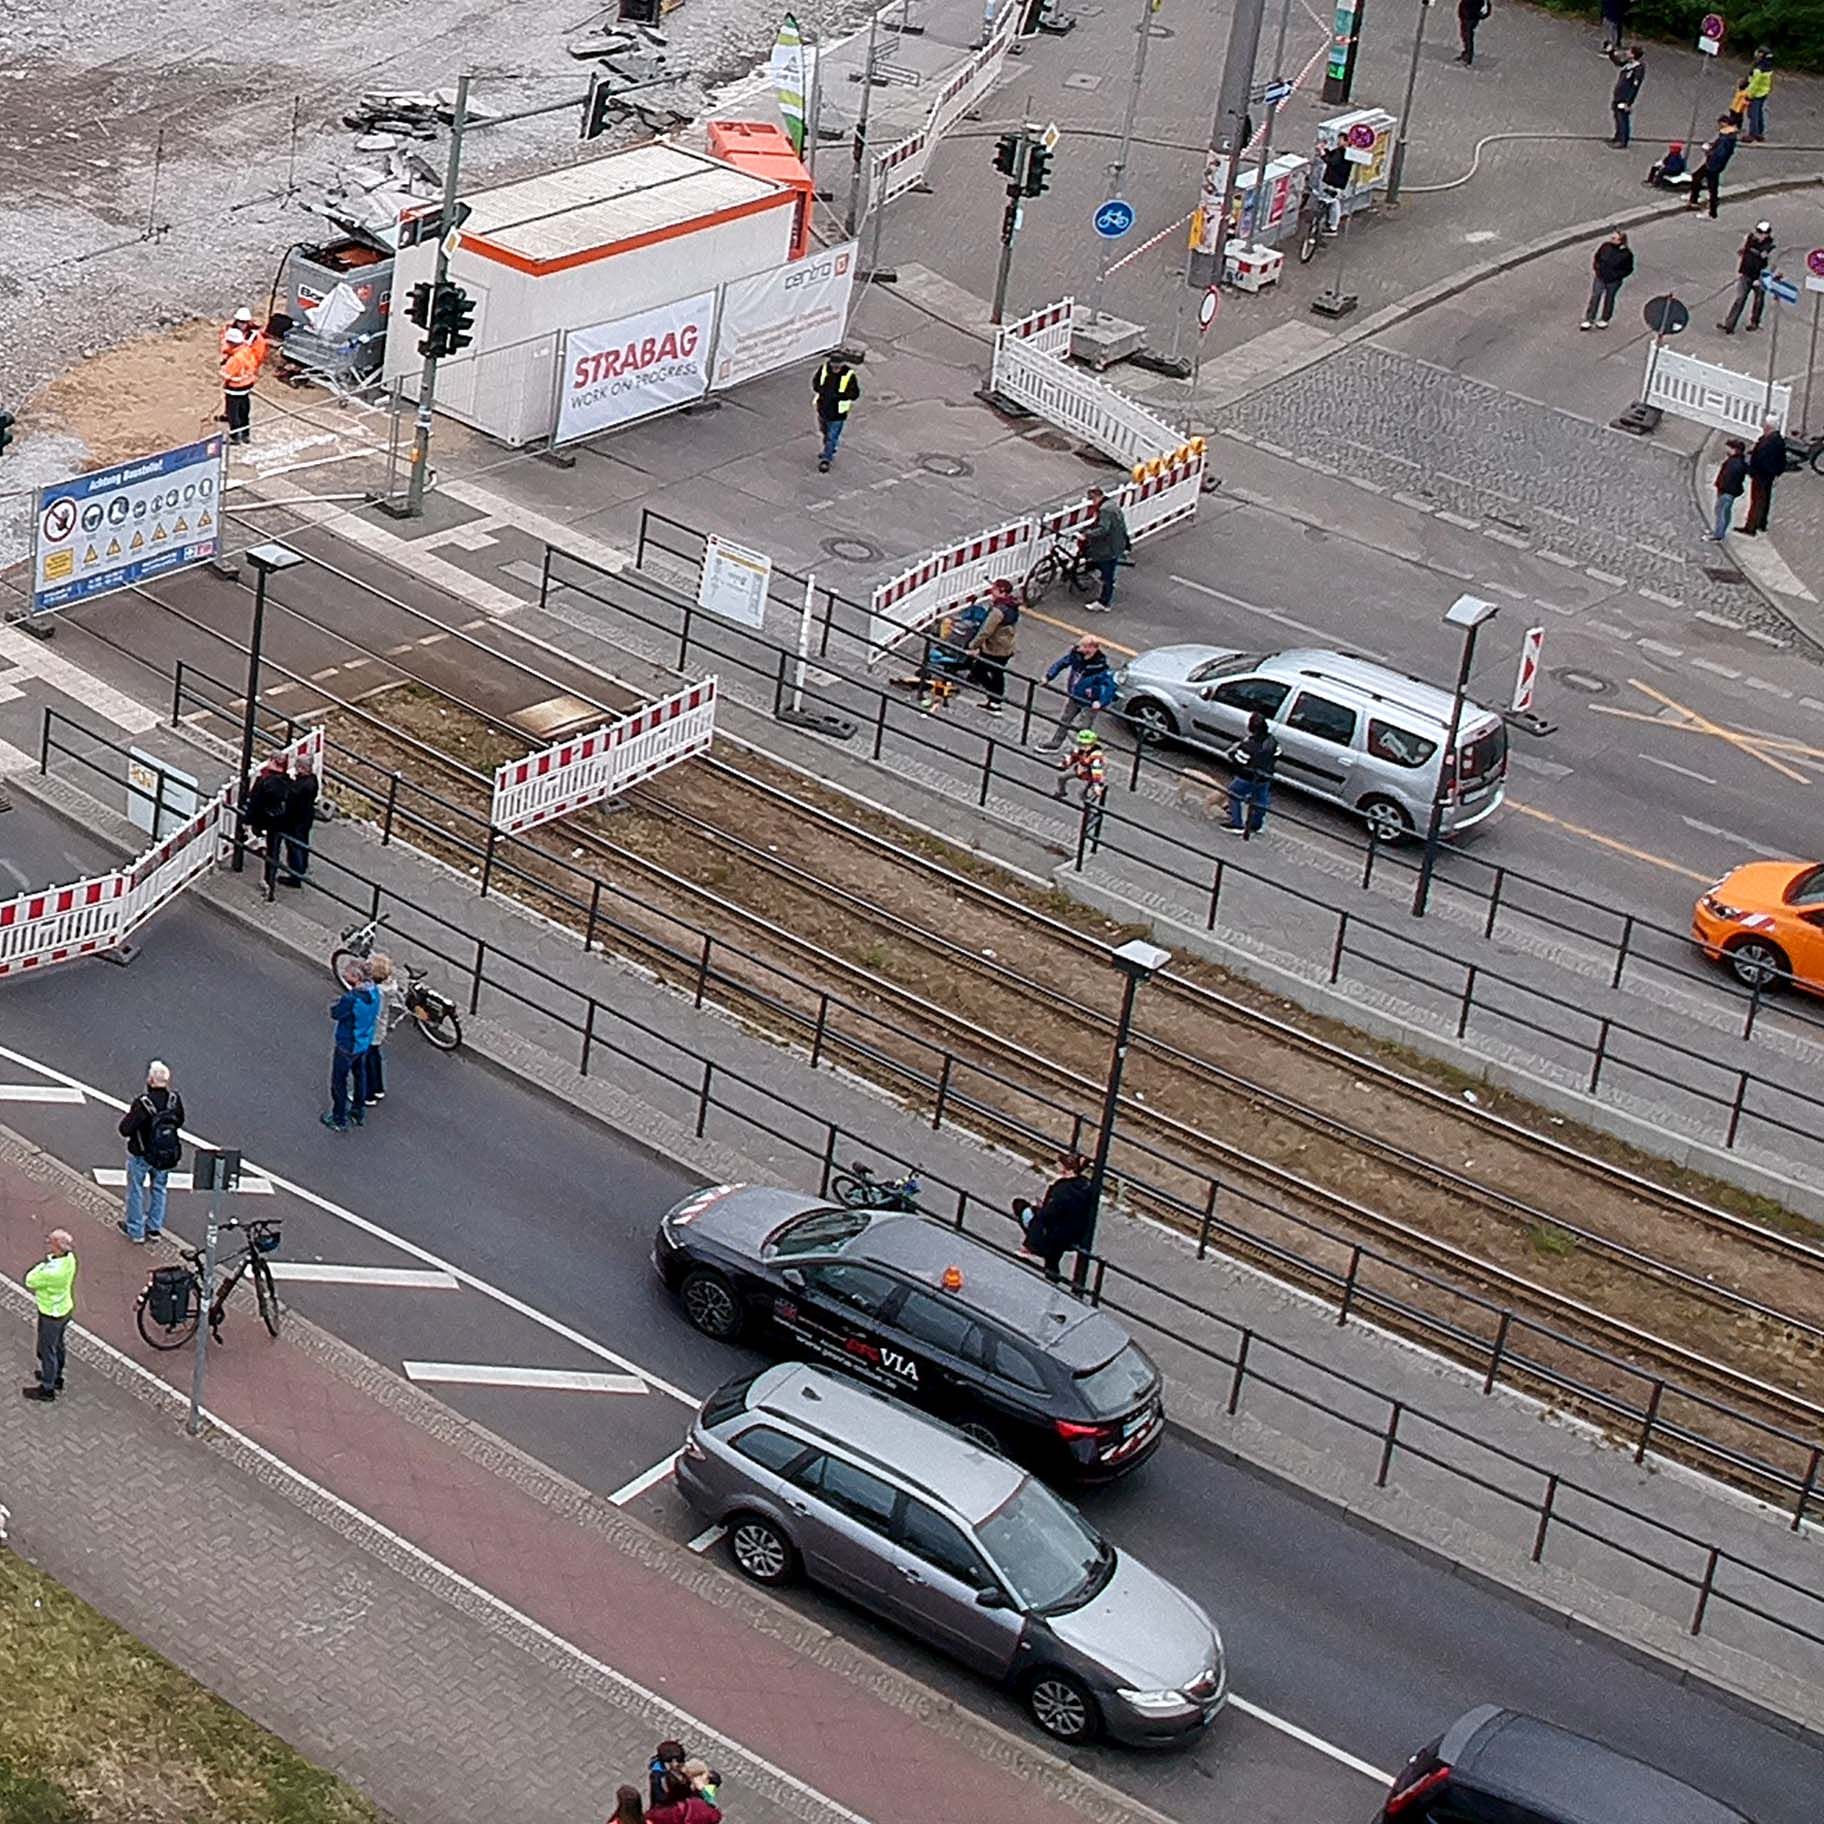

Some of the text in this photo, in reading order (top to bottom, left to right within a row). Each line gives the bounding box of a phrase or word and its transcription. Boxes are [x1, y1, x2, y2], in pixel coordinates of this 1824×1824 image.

[570, 361, 698, 409] WORK ON PROGRESS
[573, 325, 698, 389] STRABAG
